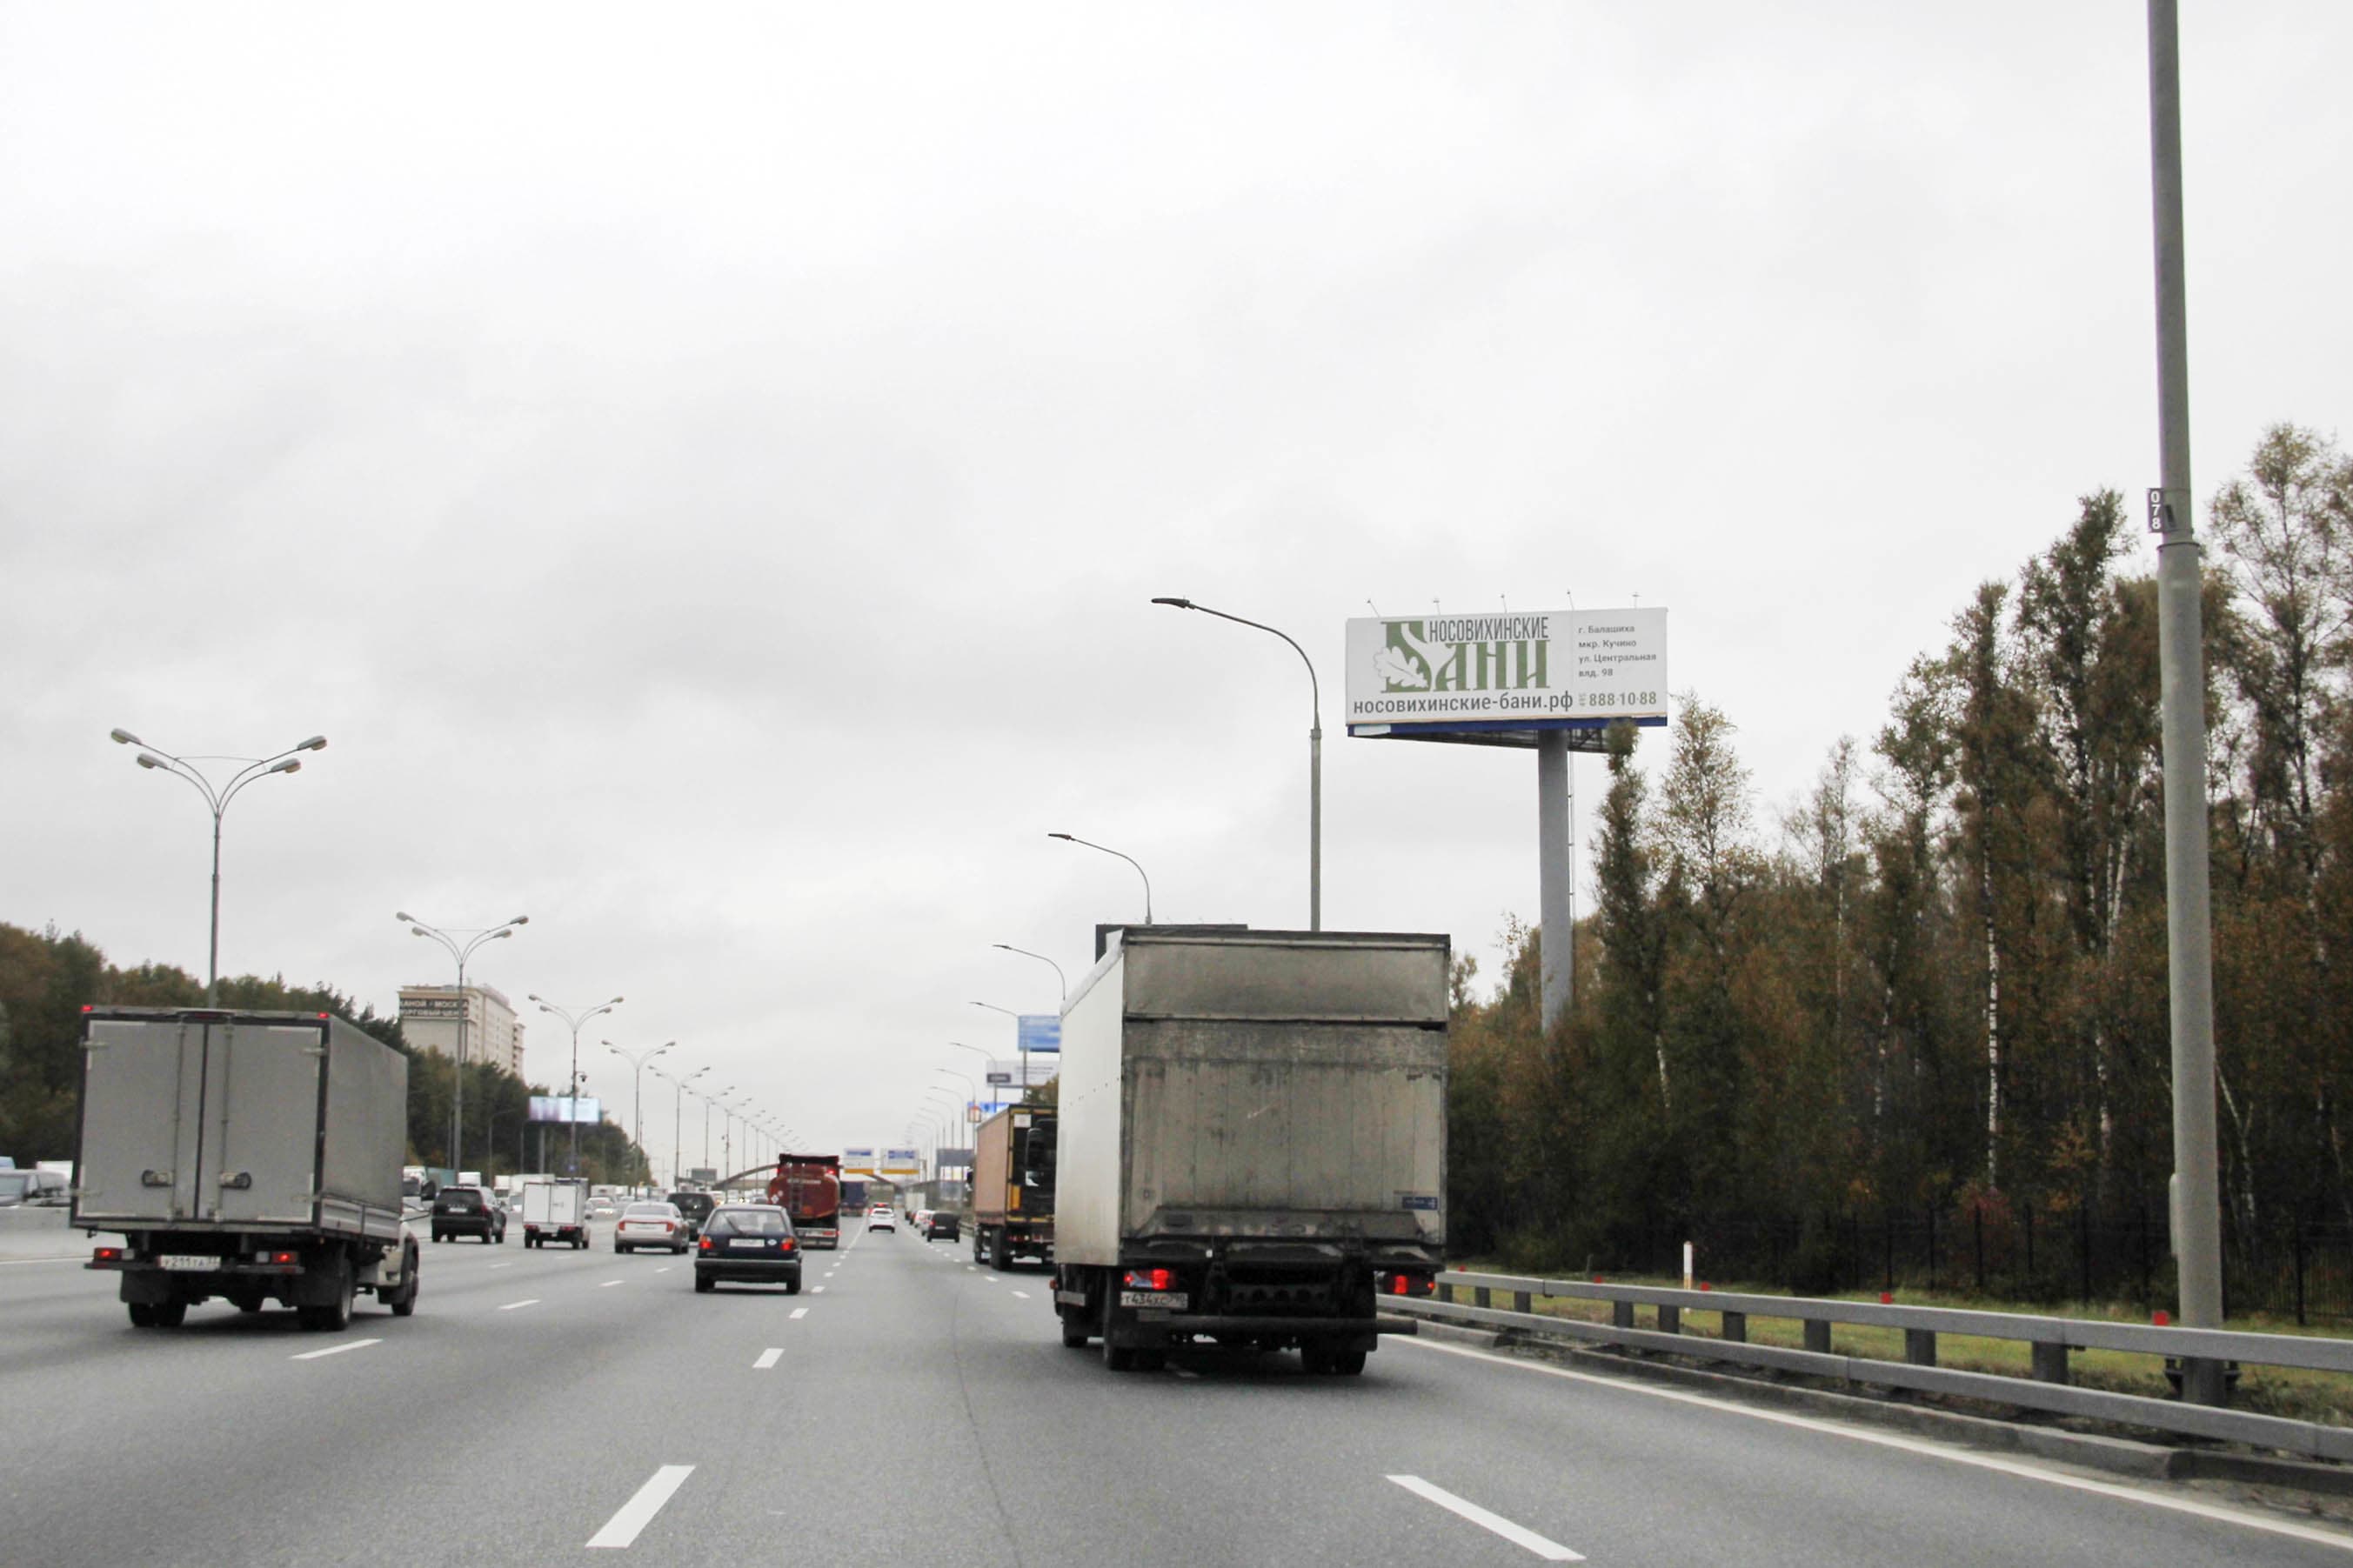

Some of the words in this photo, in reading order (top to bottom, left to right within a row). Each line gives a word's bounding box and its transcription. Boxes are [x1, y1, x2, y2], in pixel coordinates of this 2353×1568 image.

[2150, 490, 2162, 530] 078
[1429, 617, 1549, 643] НОСОВИХИНСКИЕ
[1588, 625, 1635, 634] Балашиха
[1578, 640, 1601, 649] мкр.
[1602, 639, 1637, 649] Кучино
[1380, 620, 1551, 693] БАНИ
[1594, 653, 1657, 664] Центральная
[1354, 690, 1573, 714] носовихинские-бани.рф
[435, 999, 469, 1008] МОСКА
